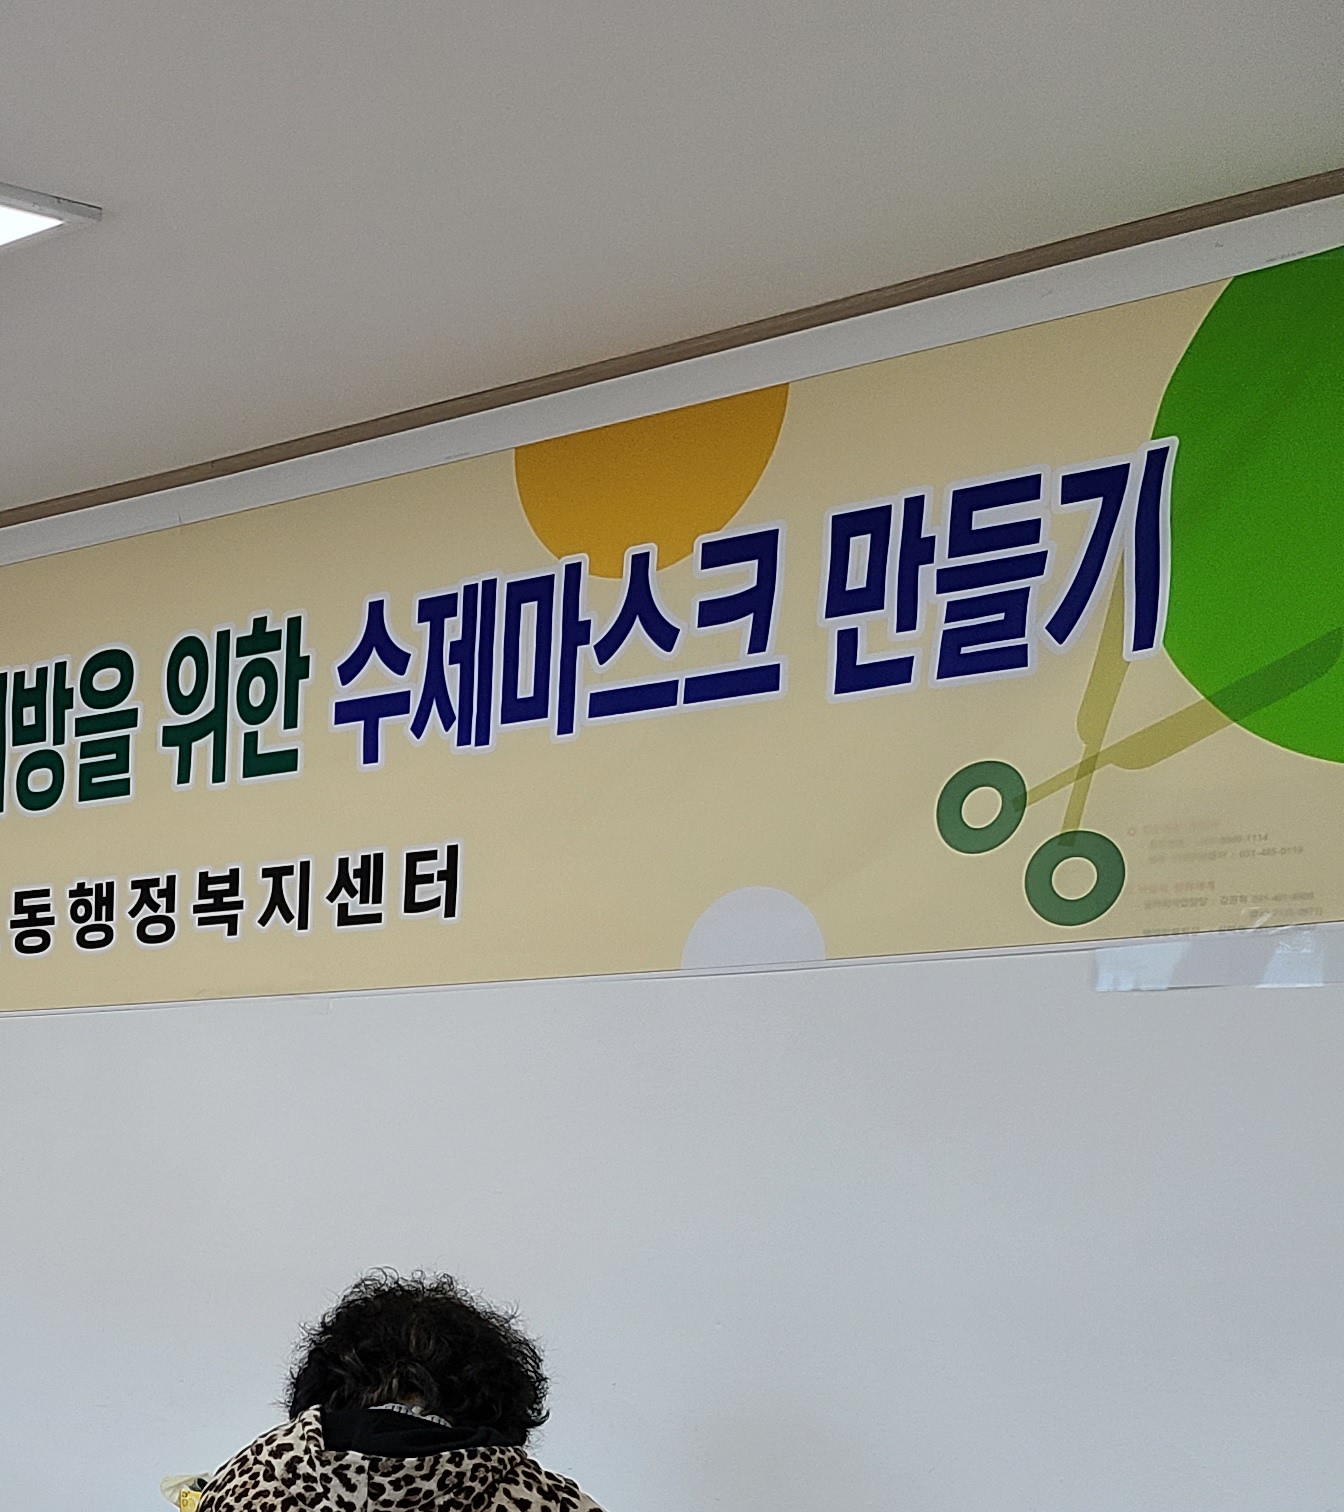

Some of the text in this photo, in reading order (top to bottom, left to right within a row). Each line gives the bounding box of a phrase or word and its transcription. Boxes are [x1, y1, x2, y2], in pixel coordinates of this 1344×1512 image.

[161, 615, 312, 786] 위한
[333, 528, 781, 765] 수제마스크
[824, 443, 1174, 696] 만들기
